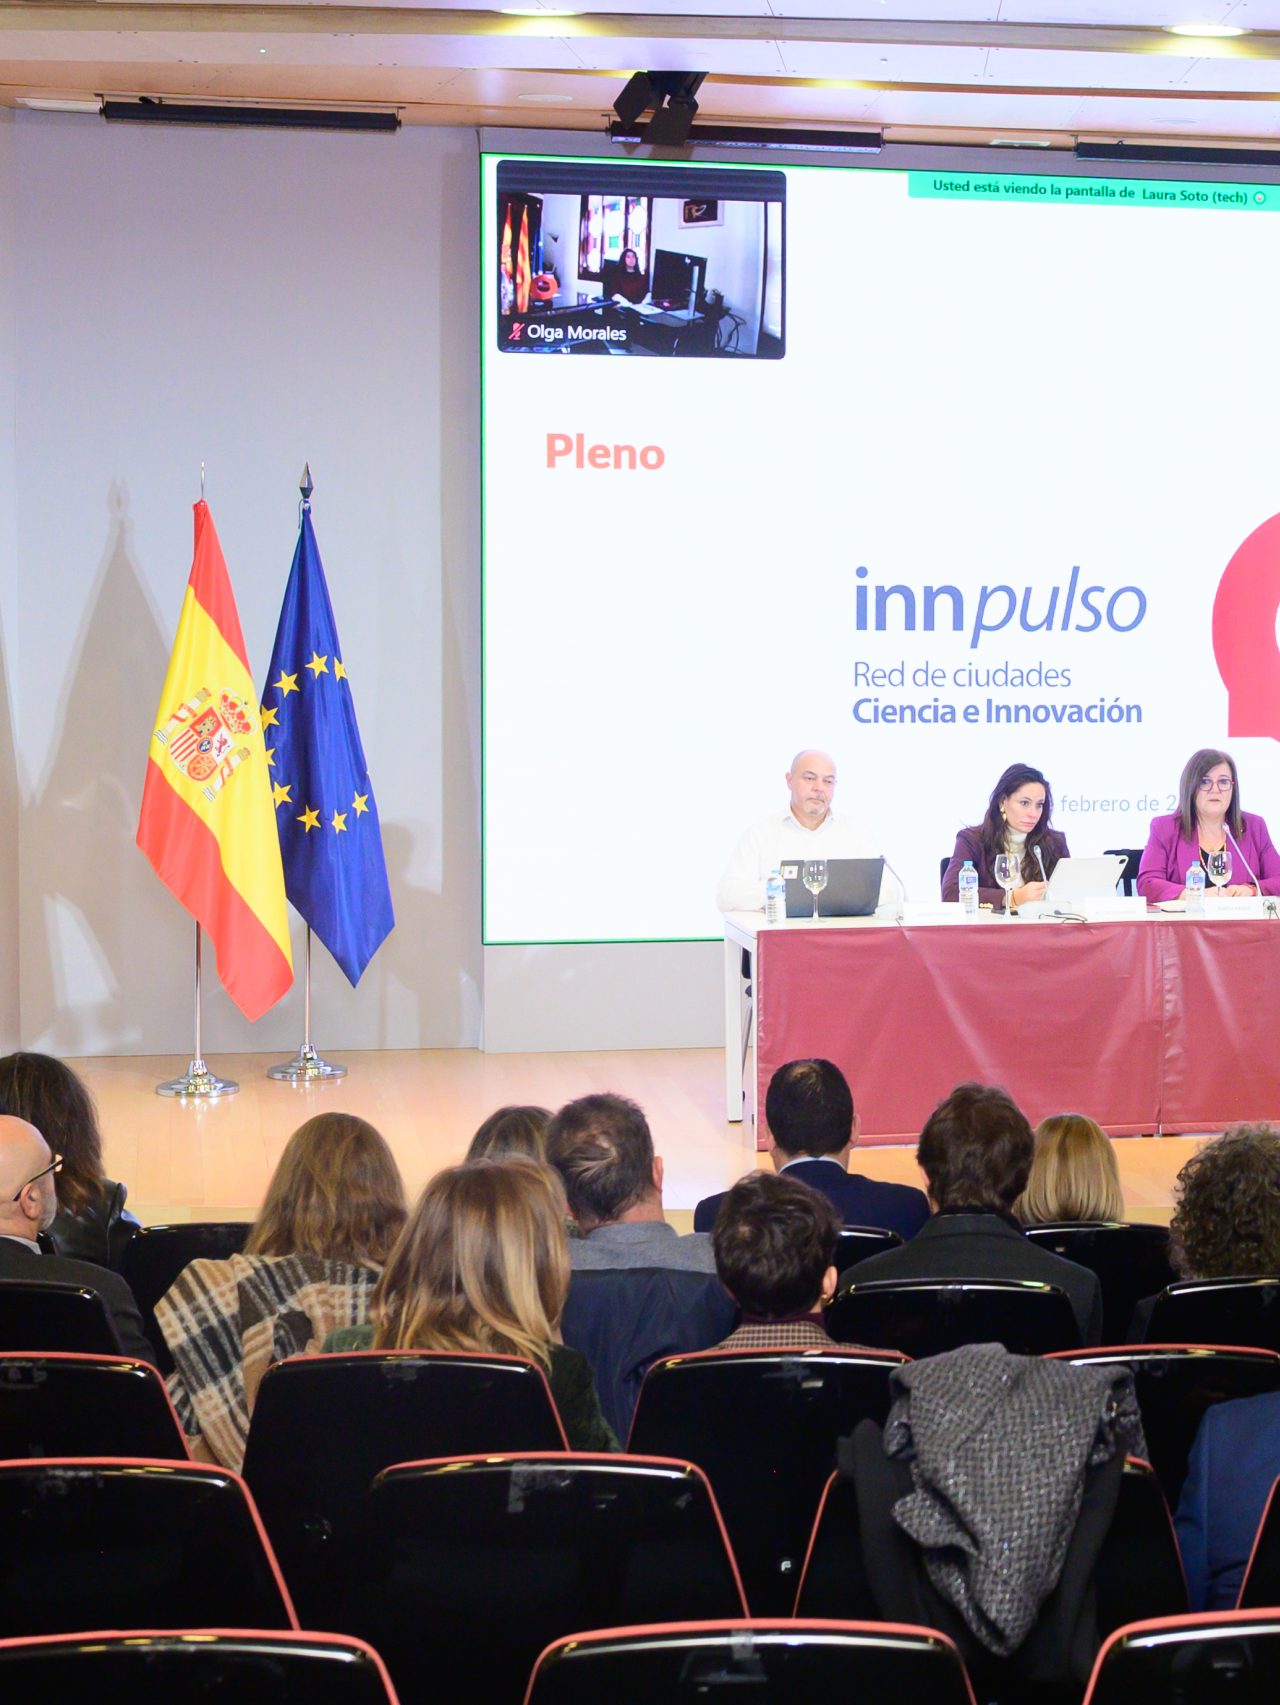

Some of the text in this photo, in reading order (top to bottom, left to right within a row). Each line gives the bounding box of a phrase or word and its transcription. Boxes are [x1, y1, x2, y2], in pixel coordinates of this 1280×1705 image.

[934, 180, 1247, 205] Usted está viendo la pantalla de Laura Soto (tech)
[527, 324, 627, 342] Olga Morales
[547, 433, 665, 470] Pleno
[856, 566, 1146, 649] innpulso
[855, 661, 1071, 687] Red de ciudades
[853, 697, 1142, 723] Ciencia e Innovación
[1061, 795, 1130, 812] febrero
[1137, 795, 1159, 811] de
